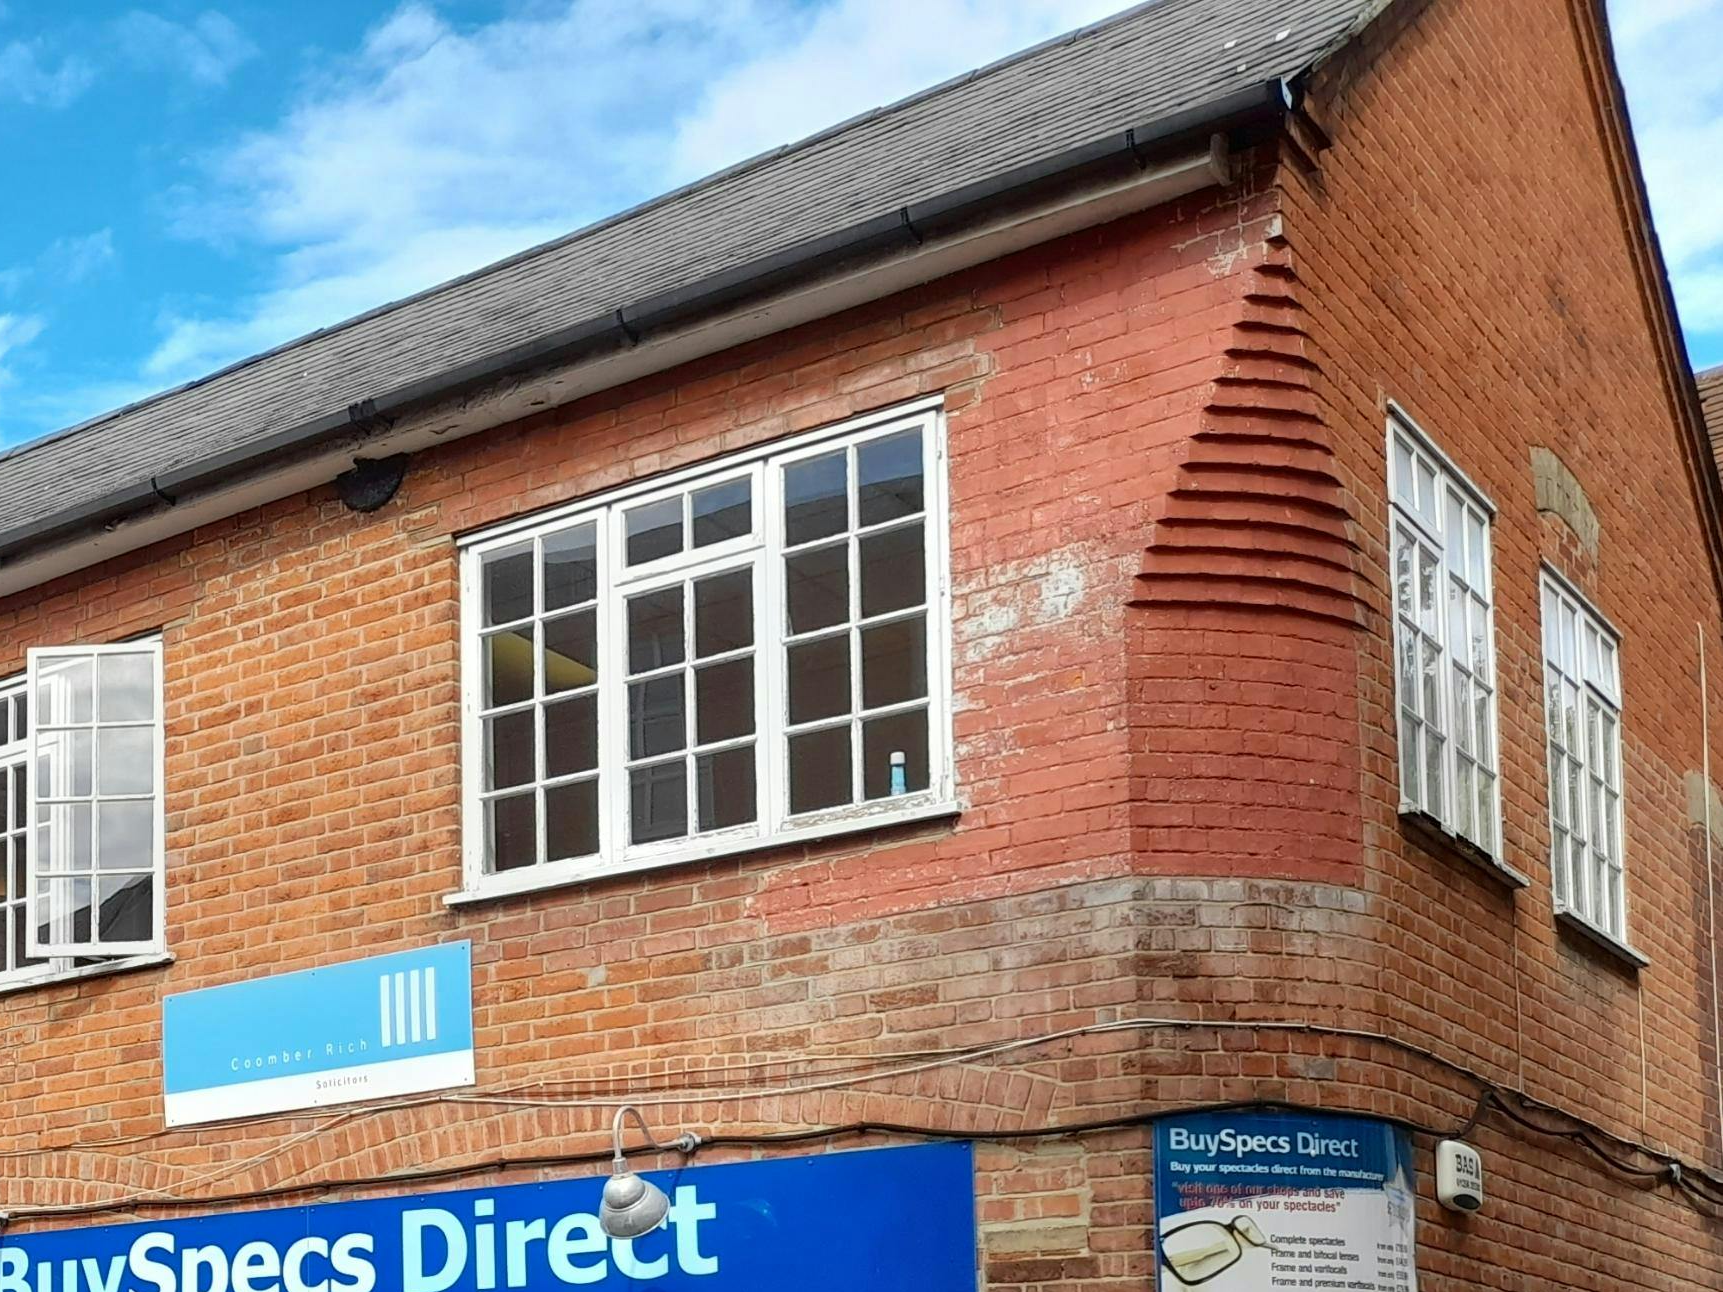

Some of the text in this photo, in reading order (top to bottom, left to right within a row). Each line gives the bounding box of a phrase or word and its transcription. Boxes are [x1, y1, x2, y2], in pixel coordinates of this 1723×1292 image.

[231, 1039, 367, 1071] Coomber Rich
[316, 1074, 368, 1089] Solicitors
[1170, 1127, 1358, 1158] BuySpecs Direct
[1170, 1162, 1191, 1174] Buy
[1193, 1163, 1216, 1174] your
[1219, 1162, 1269, 1175] spectacles
[1271, 1163, 1297, 1175] direct
[1300, 1165, 1321, 1176] from
[1323, 1166, 1337, 1177] the
[1302, 1186, 1320, 1198] and
[1323, 1188, 1345, 1199] save
[1238, 1199, 1253, 1208] on
[1257, 1199, 1280, 1212] your
[1270, 1234, 1345, 1247] Complete spectacles
[1297, 1250, 1312, 1259] and
[1271, 1262, 1296, 1272] Frame
[1298, 1263, 1313, 1273] and
[1271, 1276, 1297, 1286] Frame
[1299, 1277, 1313, 1287] and
